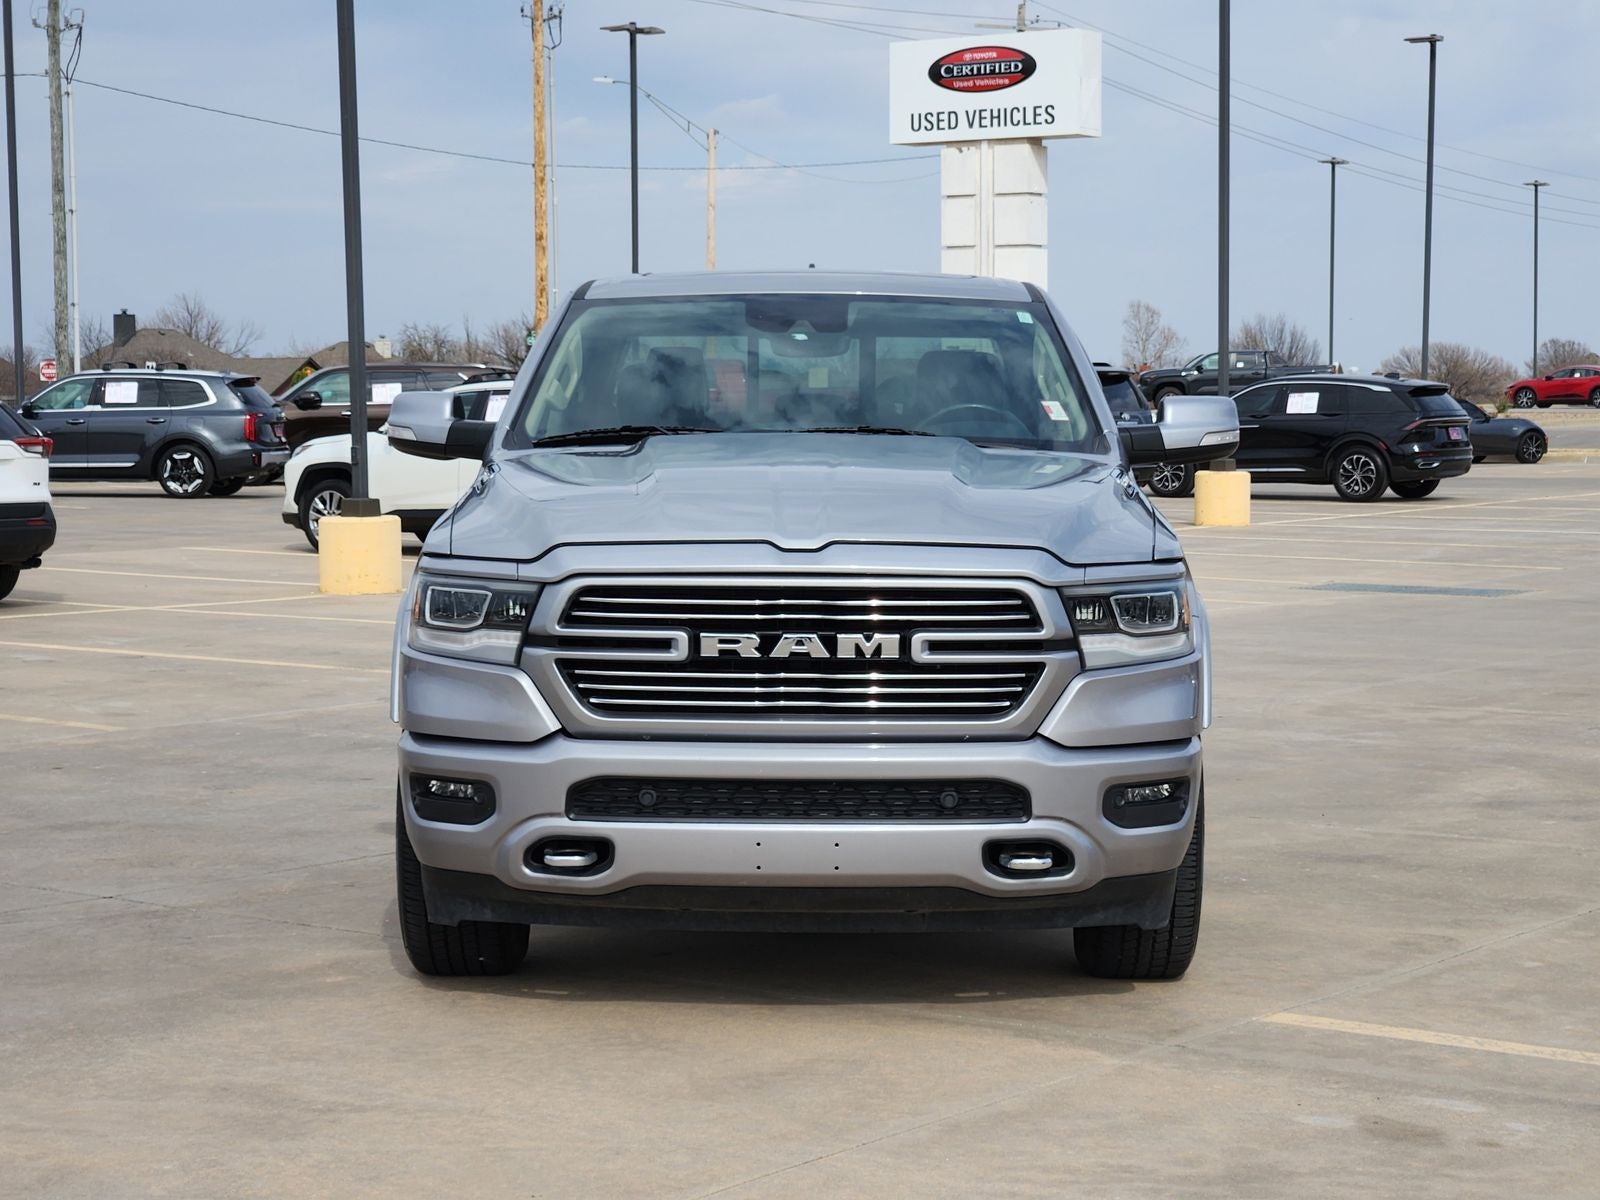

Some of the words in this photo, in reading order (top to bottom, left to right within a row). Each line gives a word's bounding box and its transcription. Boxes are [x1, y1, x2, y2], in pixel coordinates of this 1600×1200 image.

[972, 51, 997, 60] TOYOTA
[953, 80, 974, 88] Used
[975, 78, 1010, 86] Vehicles
[910, 110, 959, 132] USED
[965, 104, 1056, 129] VEHICLES
[700, 632, 901, 658] RAM
